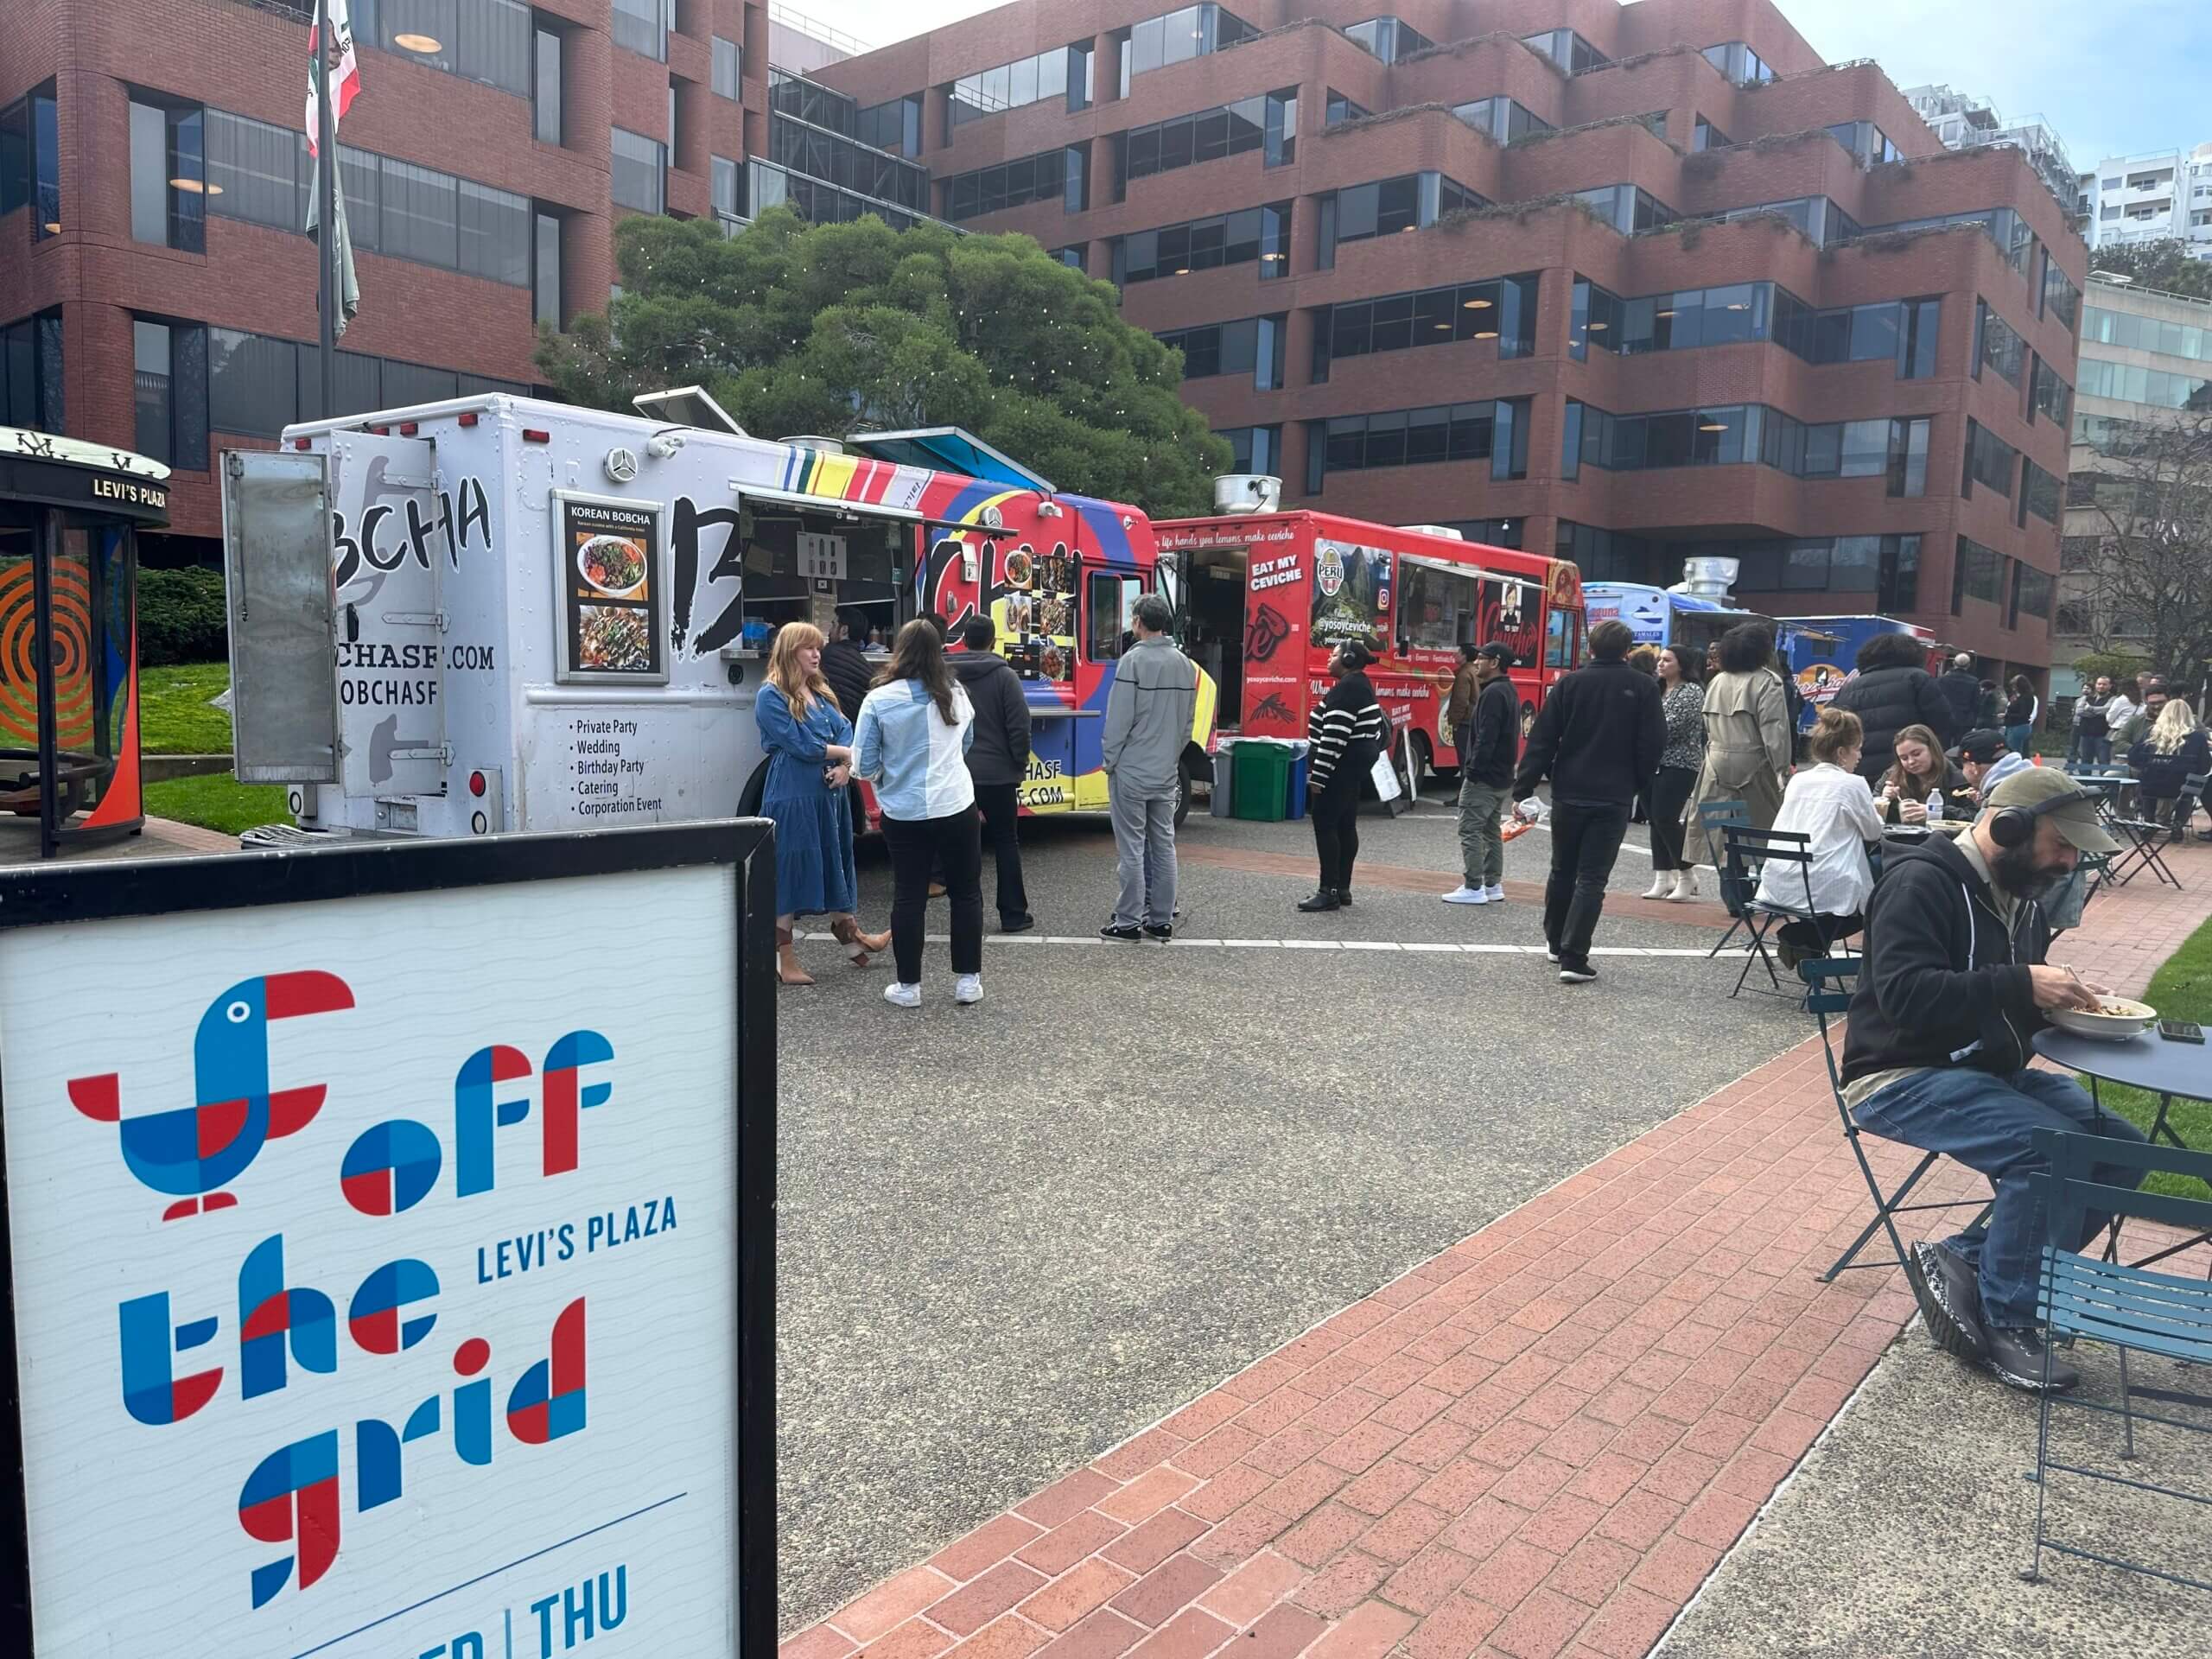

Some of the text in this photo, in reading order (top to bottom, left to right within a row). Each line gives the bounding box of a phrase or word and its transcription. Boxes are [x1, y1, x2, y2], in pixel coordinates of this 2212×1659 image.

[93, 479, 166, 508] LEVI'S PLAZA
[570, 505, 651, 525] KOREAN BOBCHA
[1174, 532, 1197, 547] hands
[1198, 537, 1213, 548] you
[1244, 529, 1266, 543] make
[1251, 555, 1298, 577] EAT MY
[1319, 564, 1344, 579] PERU
[1250, 569, 1303, 592] CEVICHE
[1319, 617, 1371, 633] @yosoyceviche
[576, 719, 638, 736] Private Party
[576, 740, 620, 757] Wedding
[578, 760, 645, 777] Birthday Party
[578, 779, 619, 797] Catering
[579, 798, 662, 817] Corporation Event
[340, 1029, 615, 1218] off
[477, 1195, 678, 1285] LEVI'S PLAZA
[118, 1233, 442, 1426] the
[238, 1296, 588, 1611] grid
[531, 1564, 627, 1659] THU
